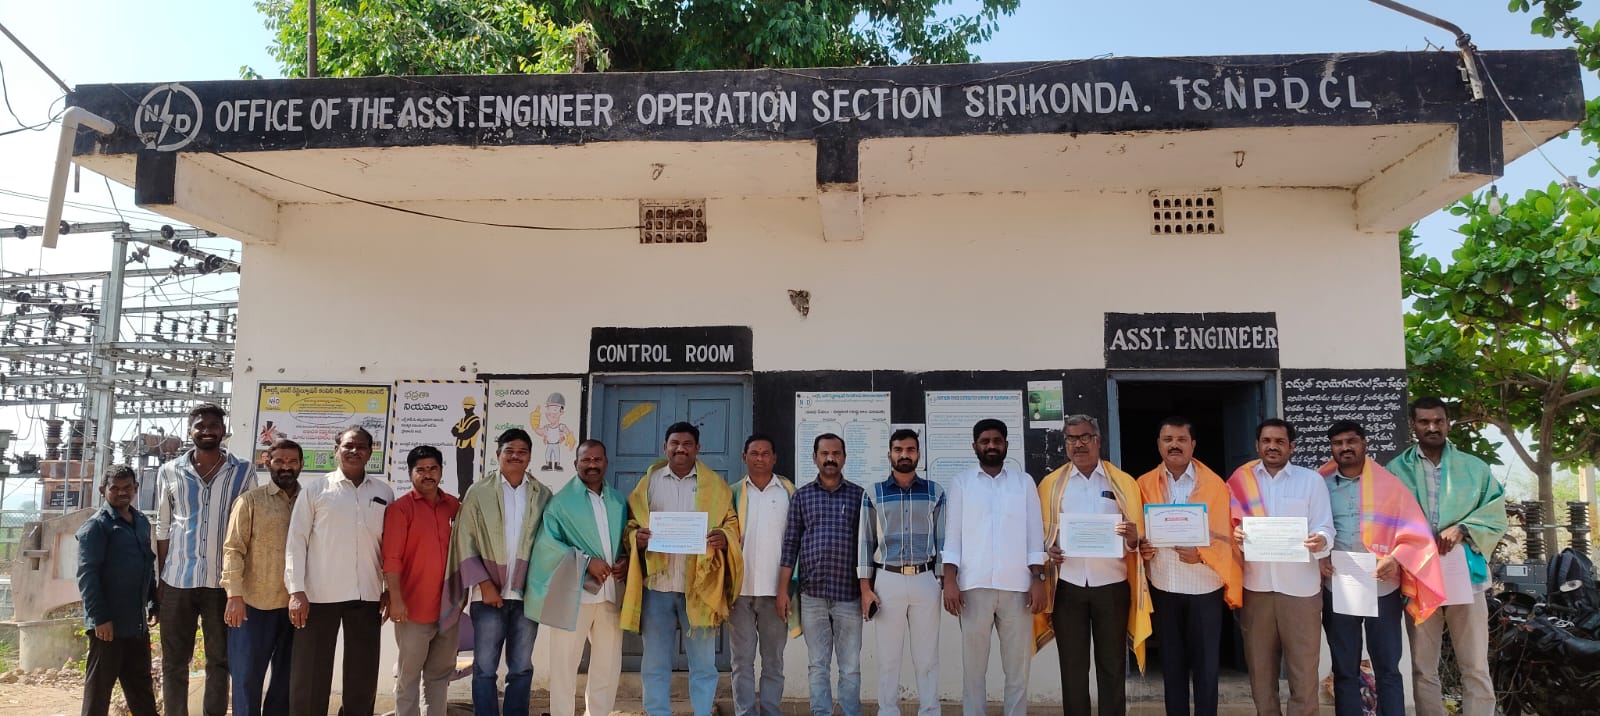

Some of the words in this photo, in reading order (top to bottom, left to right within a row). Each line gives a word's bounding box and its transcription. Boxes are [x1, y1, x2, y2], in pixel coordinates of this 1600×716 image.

[215, 99, 303, 133] OFFICE
[310, 98, 341, 130] OF
[347, 97, 395, 130] THE
[636, 91, 797, 126] OPERATION
[812, 86, 942, 123] SECTION
[1174, 325, 1278, 350] ENGINEER
[597, 344, 672, 363] CONTROL
[685, 344, 734, 363] ROOM
[403, 402, 449, 411] నియమాలు
